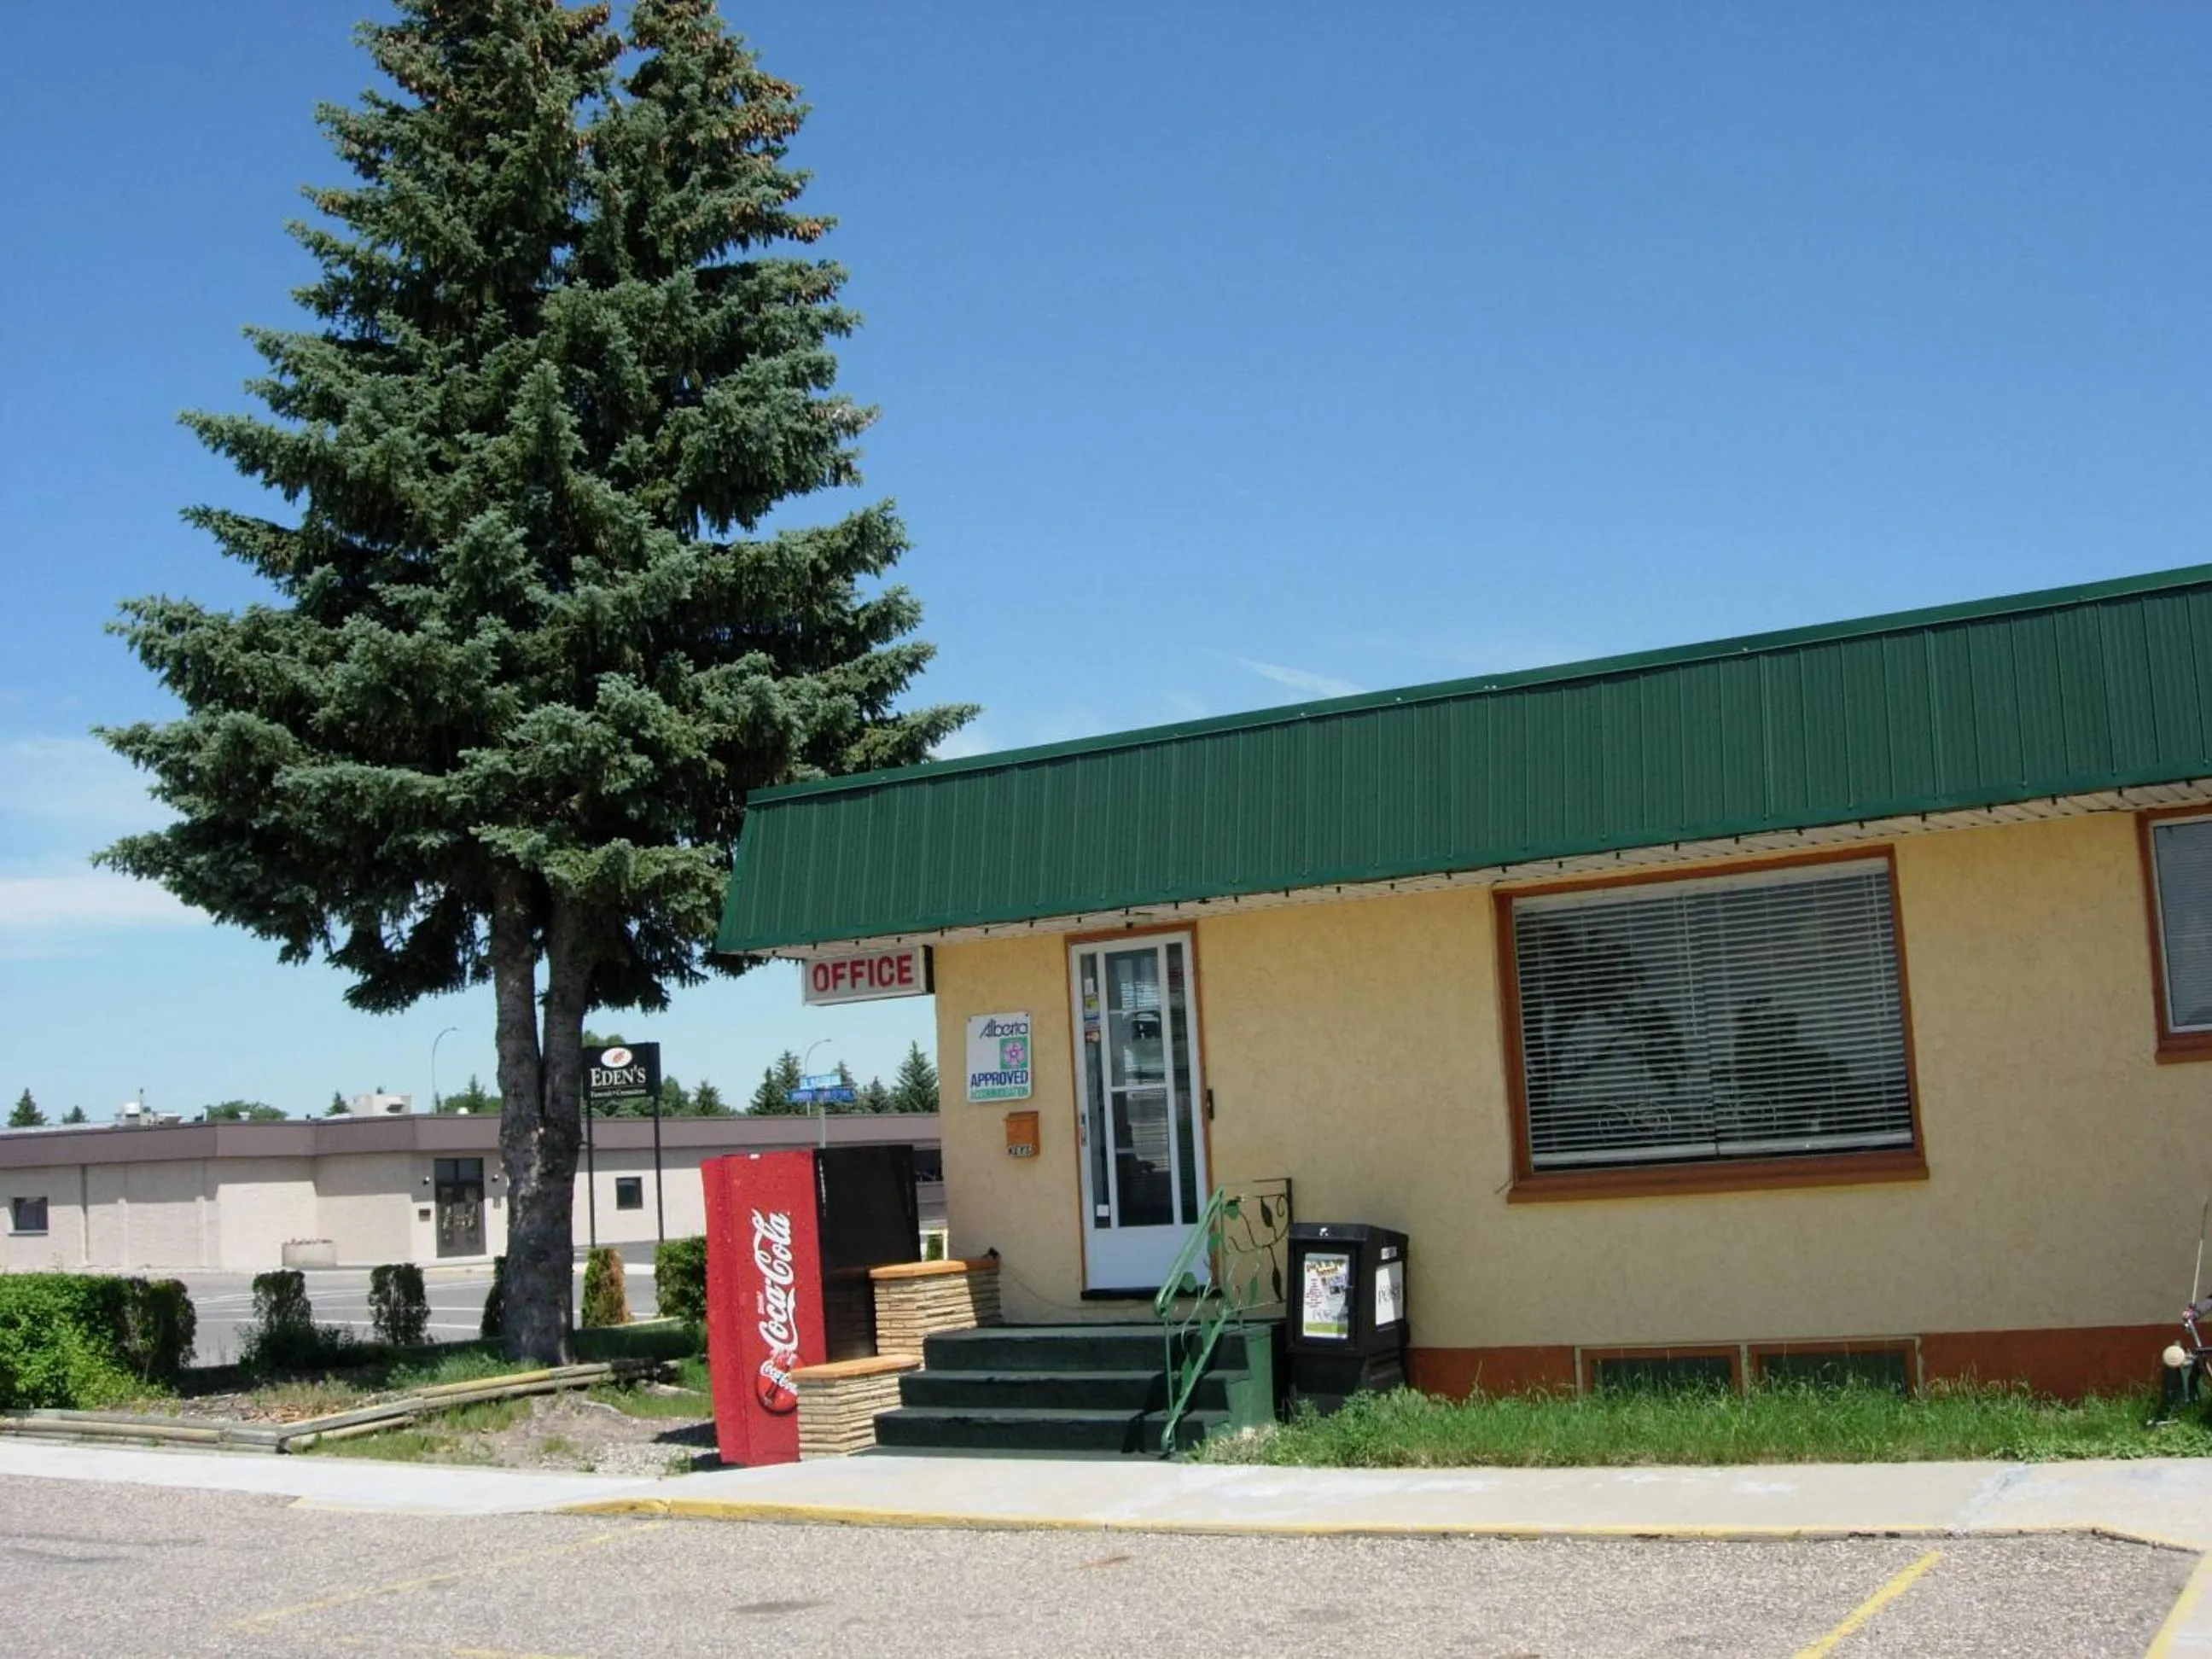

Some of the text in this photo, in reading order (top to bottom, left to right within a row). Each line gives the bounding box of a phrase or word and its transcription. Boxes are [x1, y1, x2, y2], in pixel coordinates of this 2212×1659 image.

[812, 954, 914, 992] OFFICE
[979, 1018, 1028, 1039] Alberta
[591, 1064, 646, 1087] EDEN'S
[970, 1070, 1028, 1087] APPROVED
[751, 1208, 799, 1355] Coca-Cola
